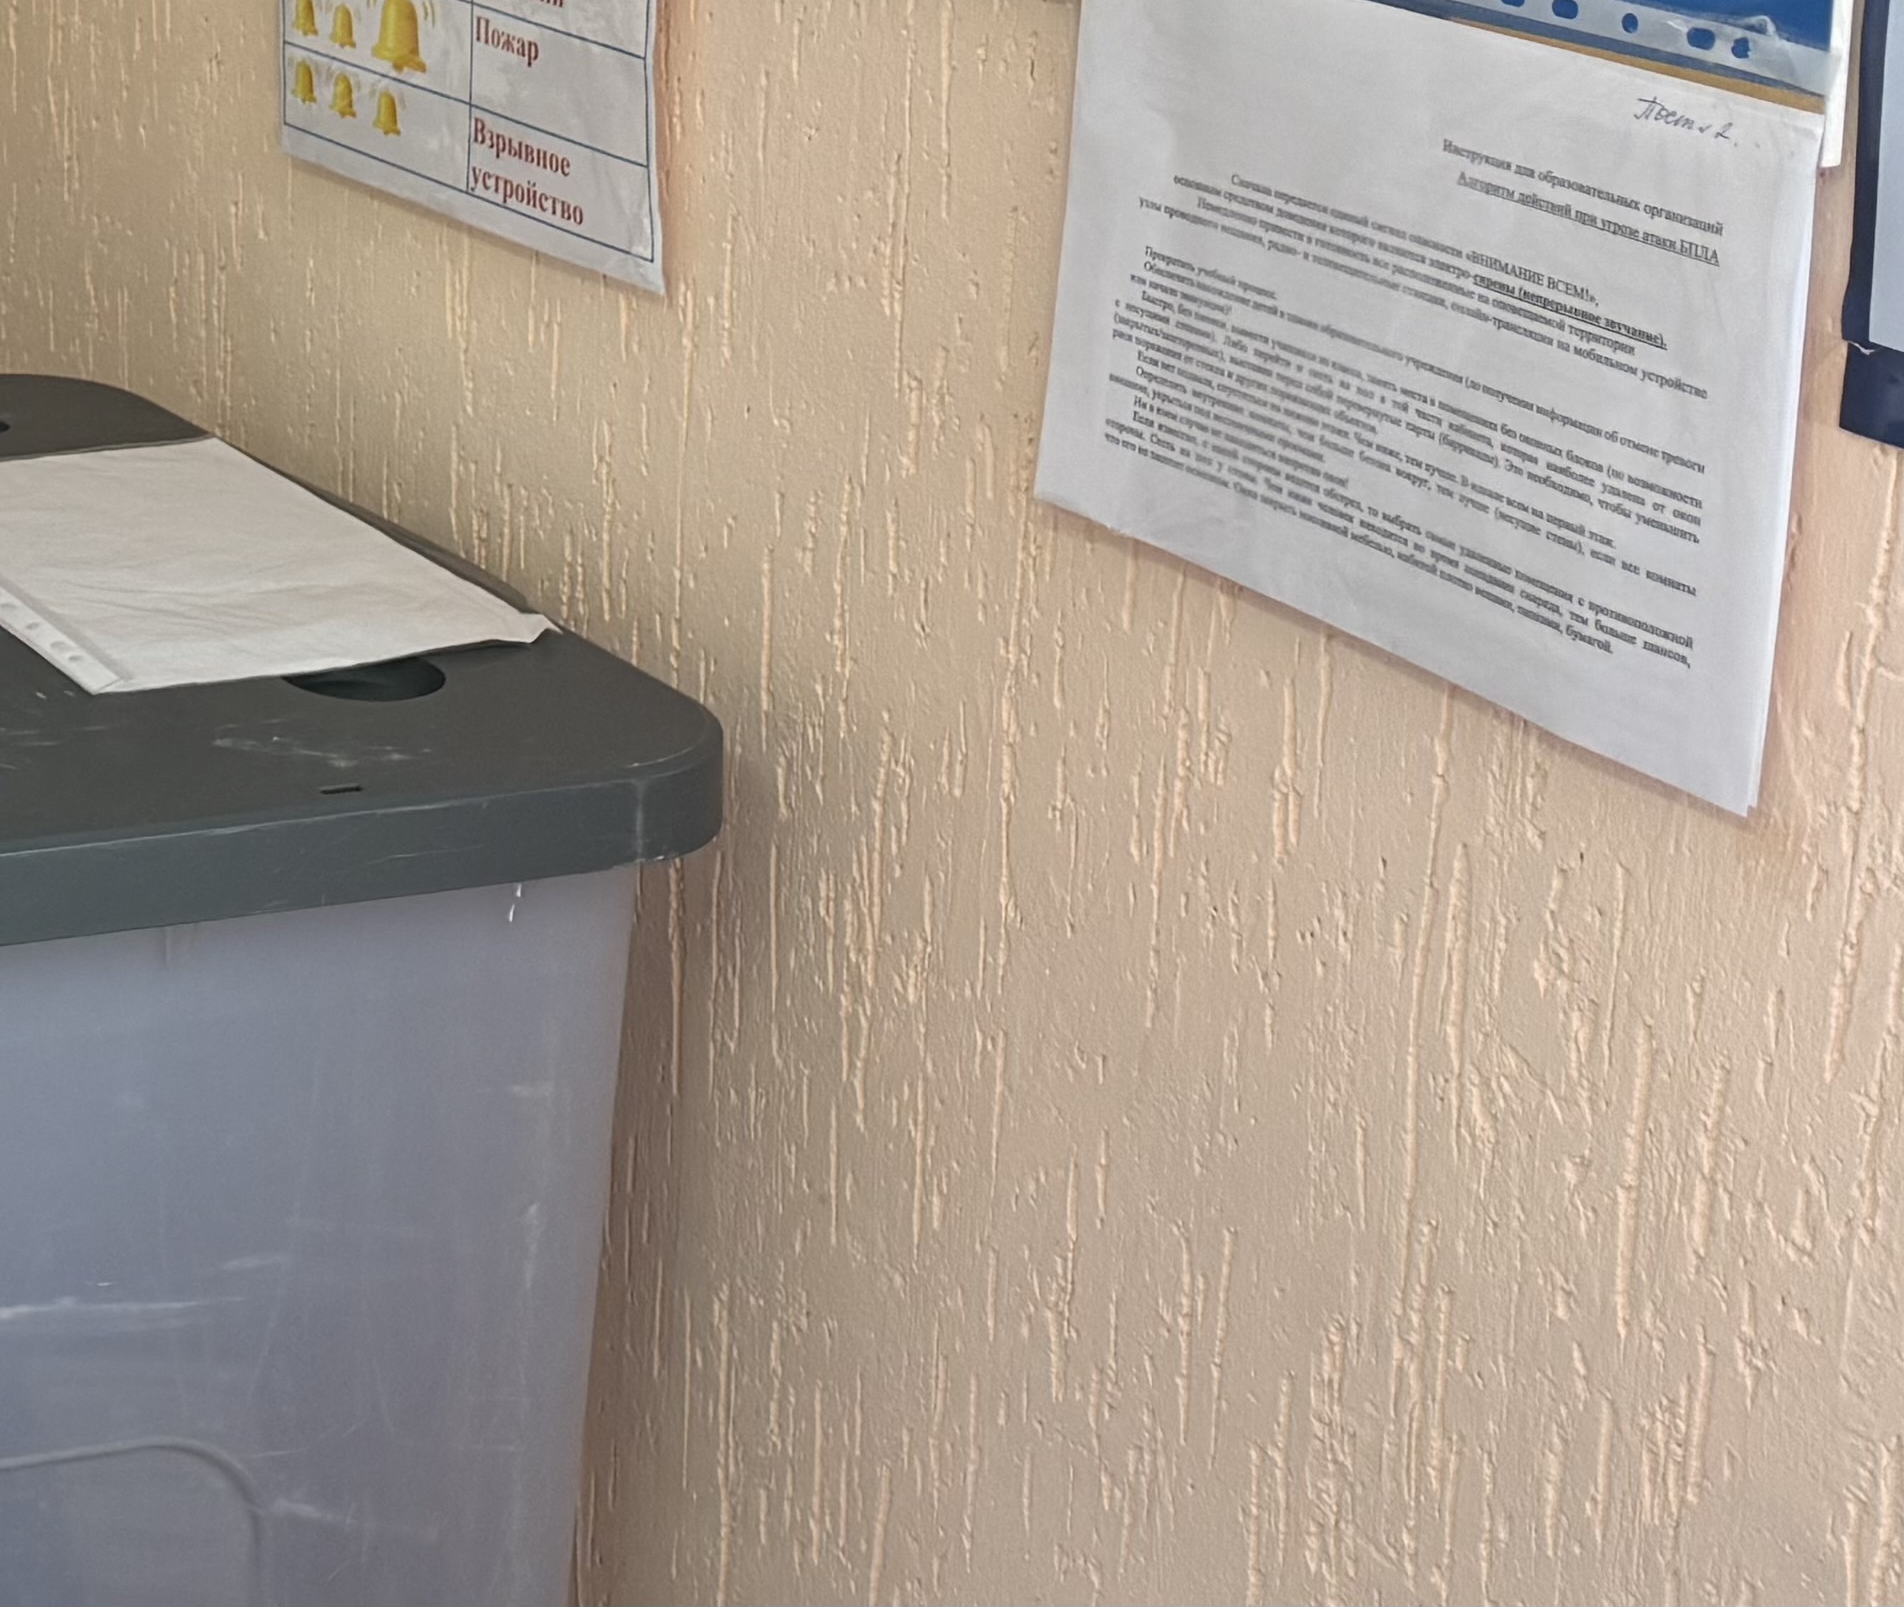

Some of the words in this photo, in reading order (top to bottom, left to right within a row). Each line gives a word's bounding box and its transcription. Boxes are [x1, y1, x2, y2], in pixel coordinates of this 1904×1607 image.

[475, 16, 539, 67] Пожар
[472, 114, 571, 178] Взрывное
[471, 165, 584, 227] устройство
[1442, 138, 1512, 172] Инструкция
[1538, 170, 1640, 212] образовательных
[1643, 203, 1724, 237] организаций
[1518, 189, 1572, 218] действий
[1574, 207, 1597, 226] при
[1641, 230, 1677, 252] атаки
[1679, 239, 1721, 266] БПЛА
